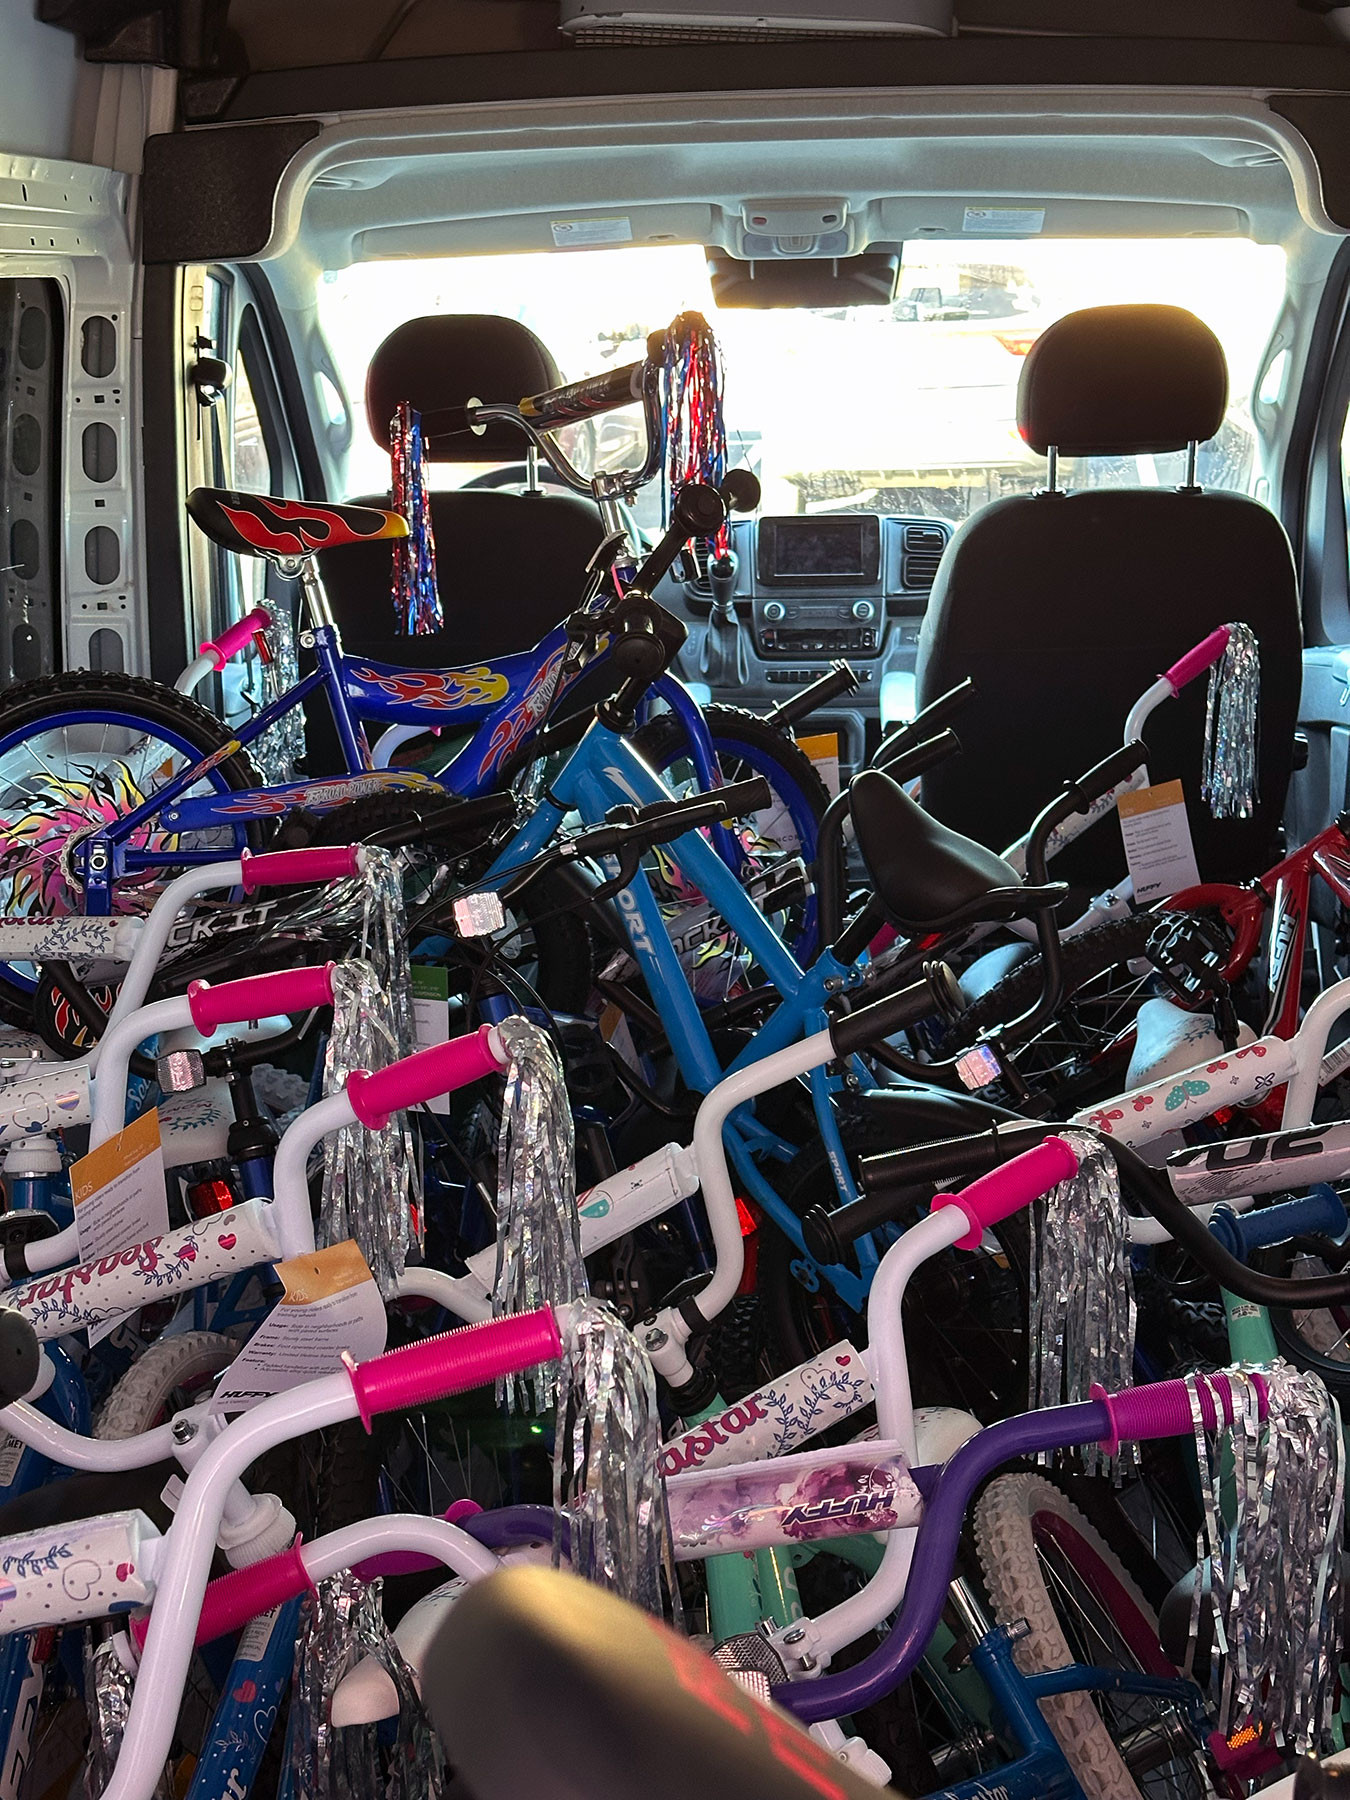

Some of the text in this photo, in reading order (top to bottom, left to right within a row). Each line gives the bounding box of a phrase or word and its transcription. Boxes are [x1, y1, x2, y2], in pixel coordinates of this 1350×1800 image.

[828, 1151, 848, 1192] SPORT
[20, 1236, 164, 1308] Seastar
[656, 1392, 769, 1478] astar
[780, 1488, 897, 1528] HUFFY
